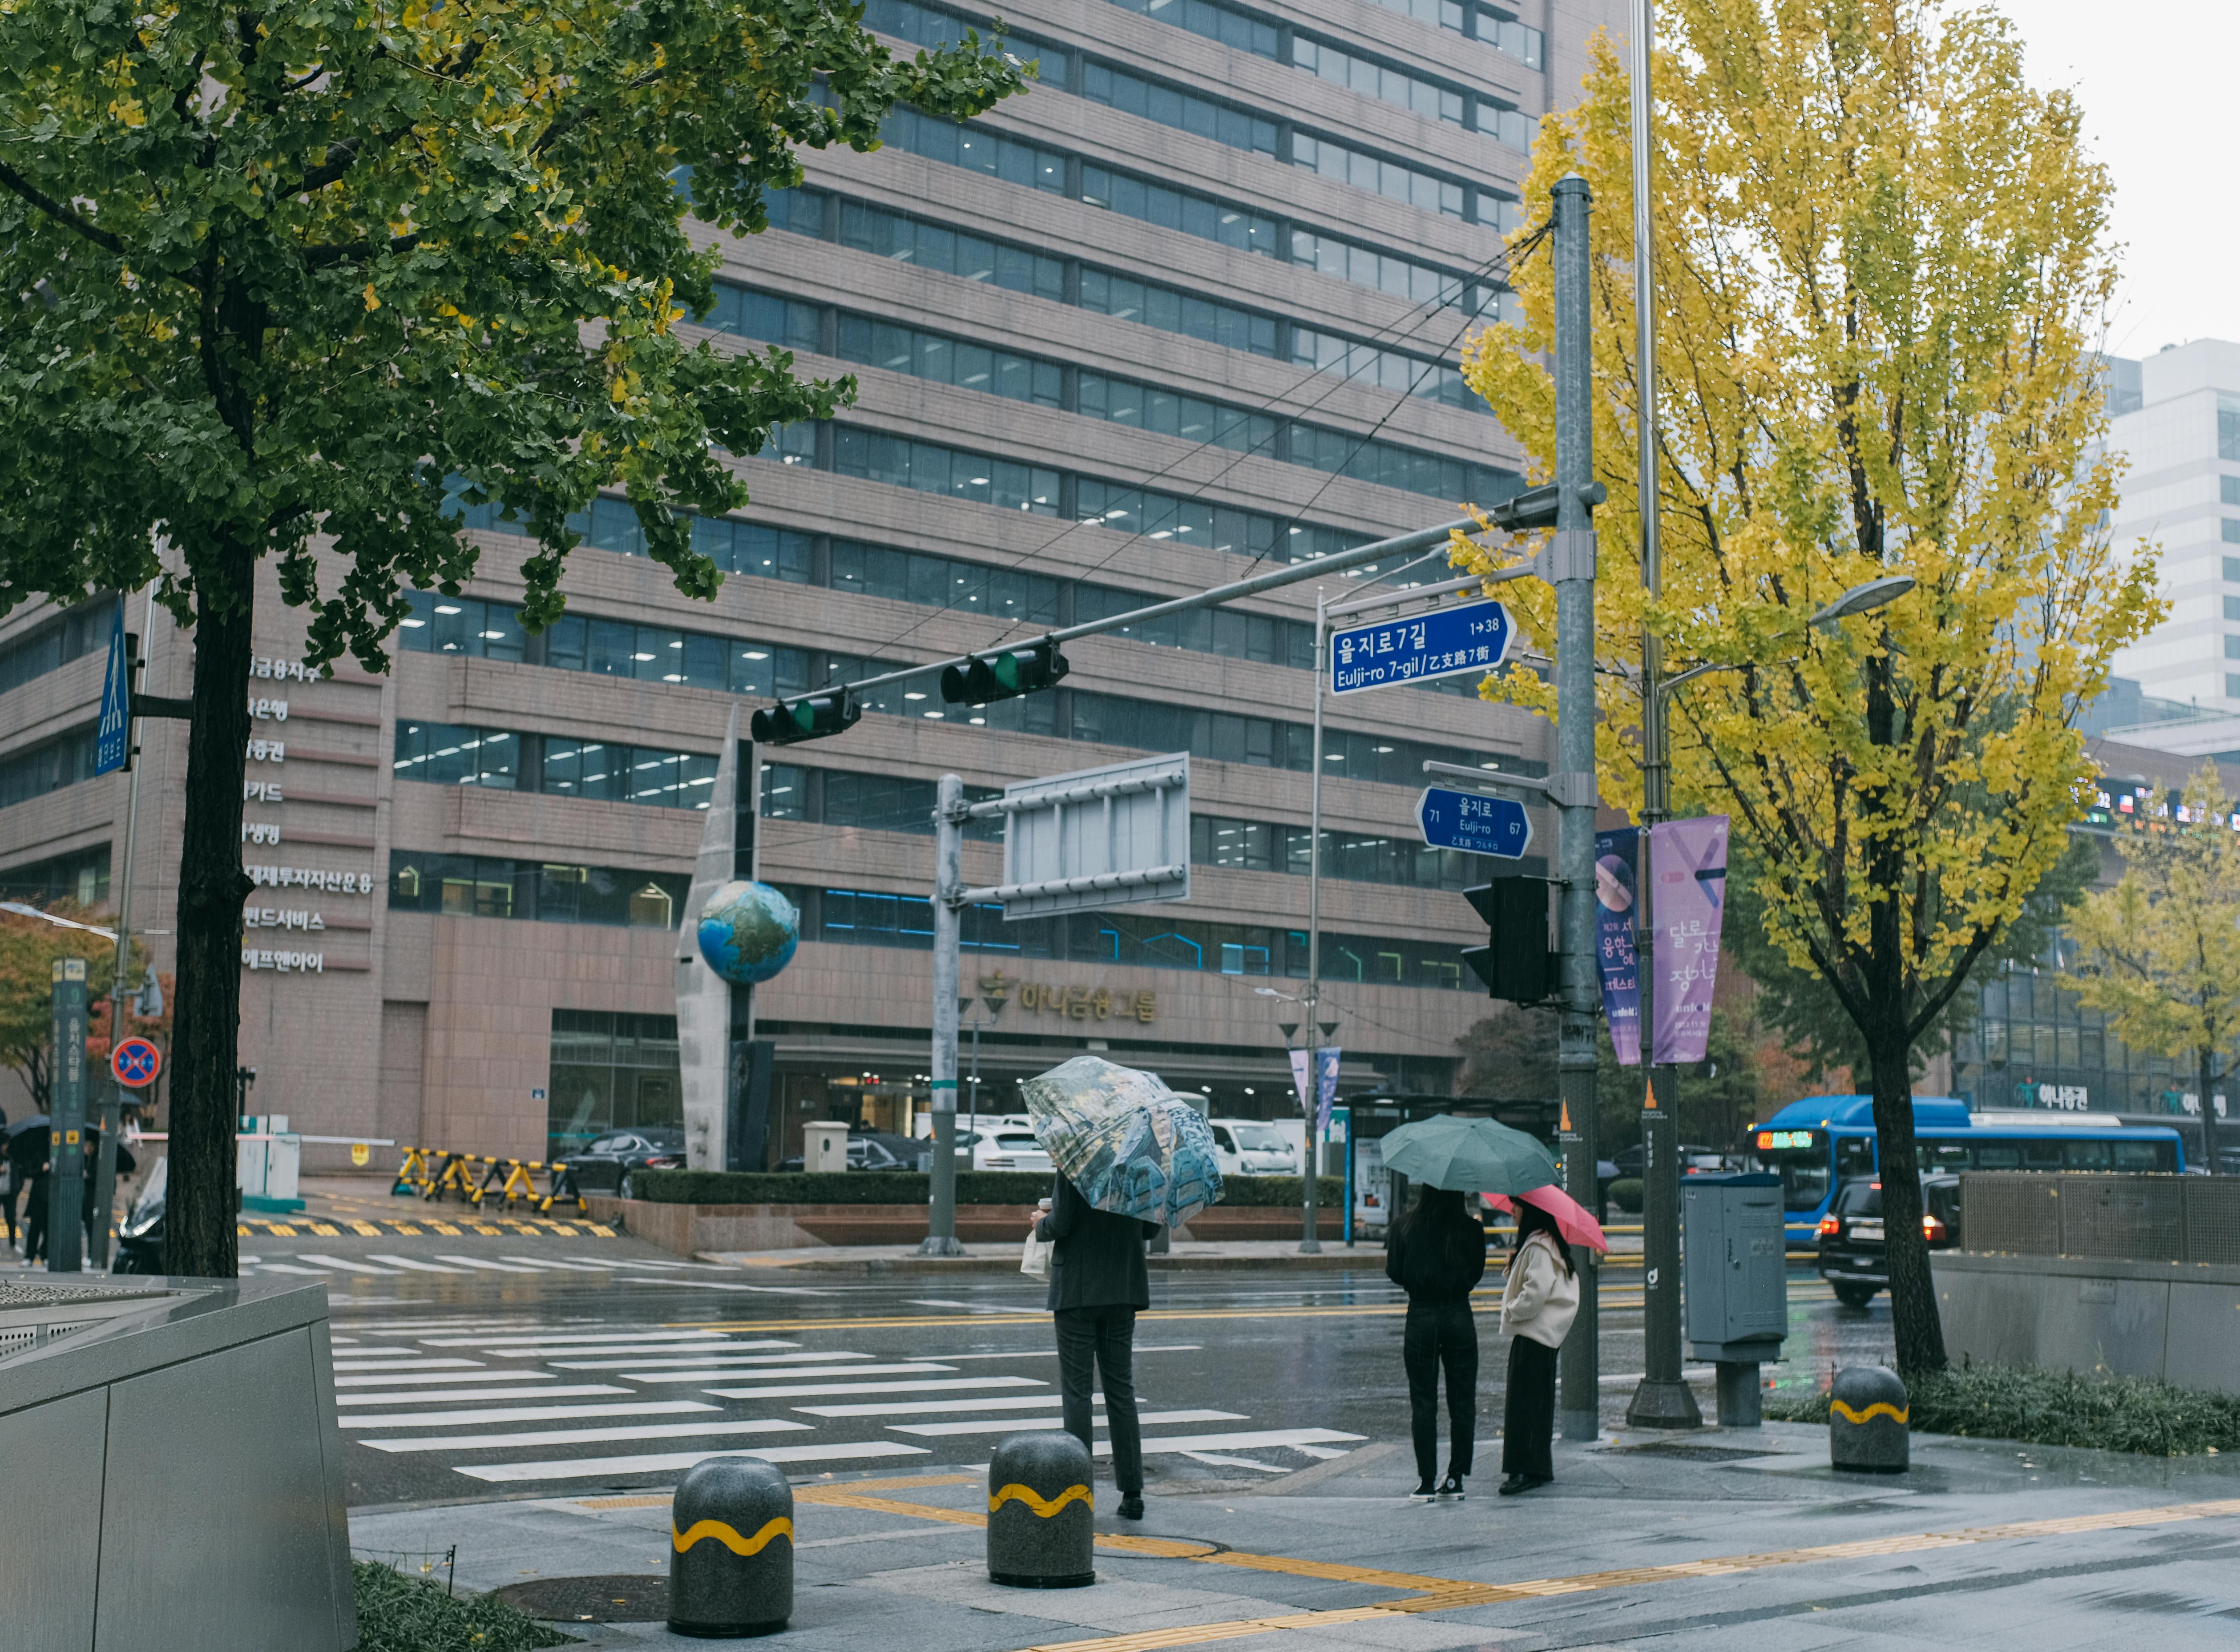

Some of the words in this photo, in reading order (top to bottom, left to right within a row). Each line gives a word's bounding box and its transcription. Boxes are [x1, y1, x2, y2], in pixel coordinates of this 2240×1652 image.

[1338, 622, 1425, 664] 을지로7길
[1338, 667, 1384, 687] Eulji-ro
[1430, 810, 1440, 823] 71
[1459, 797, 1493, 818] 을지로
[1460, 819, 1491, 834] Eulji-ro
[1509, 822, 1521, 835] 67
[1022, 982, 1156, 1023] 하나금융그룹
